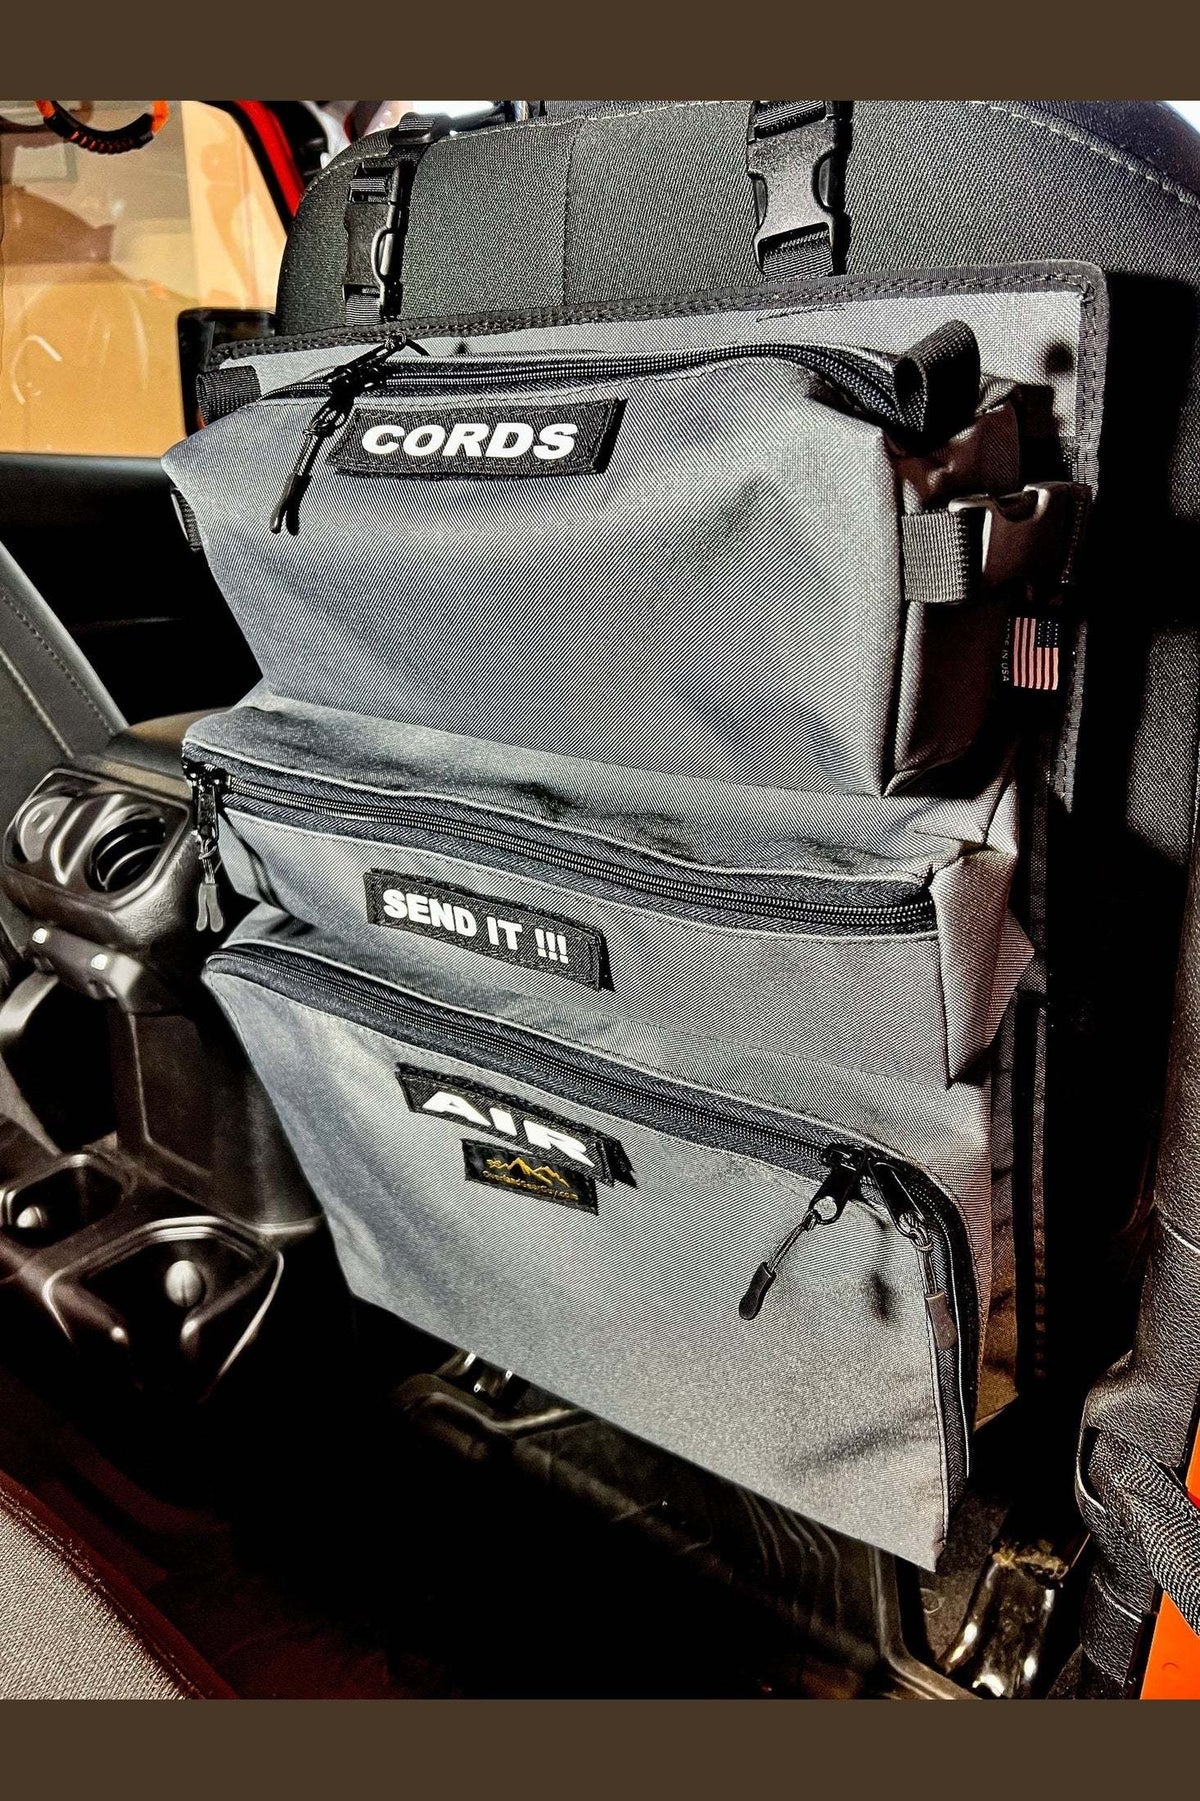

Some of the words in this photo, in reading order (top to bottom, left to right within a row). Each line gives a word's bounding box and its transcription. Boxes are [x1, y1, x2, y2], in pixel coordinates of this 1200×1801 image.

[362, 422, 578, 460] CORDS
[1001, 649, 1009, 659] IN
[1001, 663, 1010, 682] USA
[382, 888, 477, 937] SEND
[486, 916, 523, 950] IT
[534, 928, 569, 964] !!!
[422, 1091, 595, 1167] AIR
